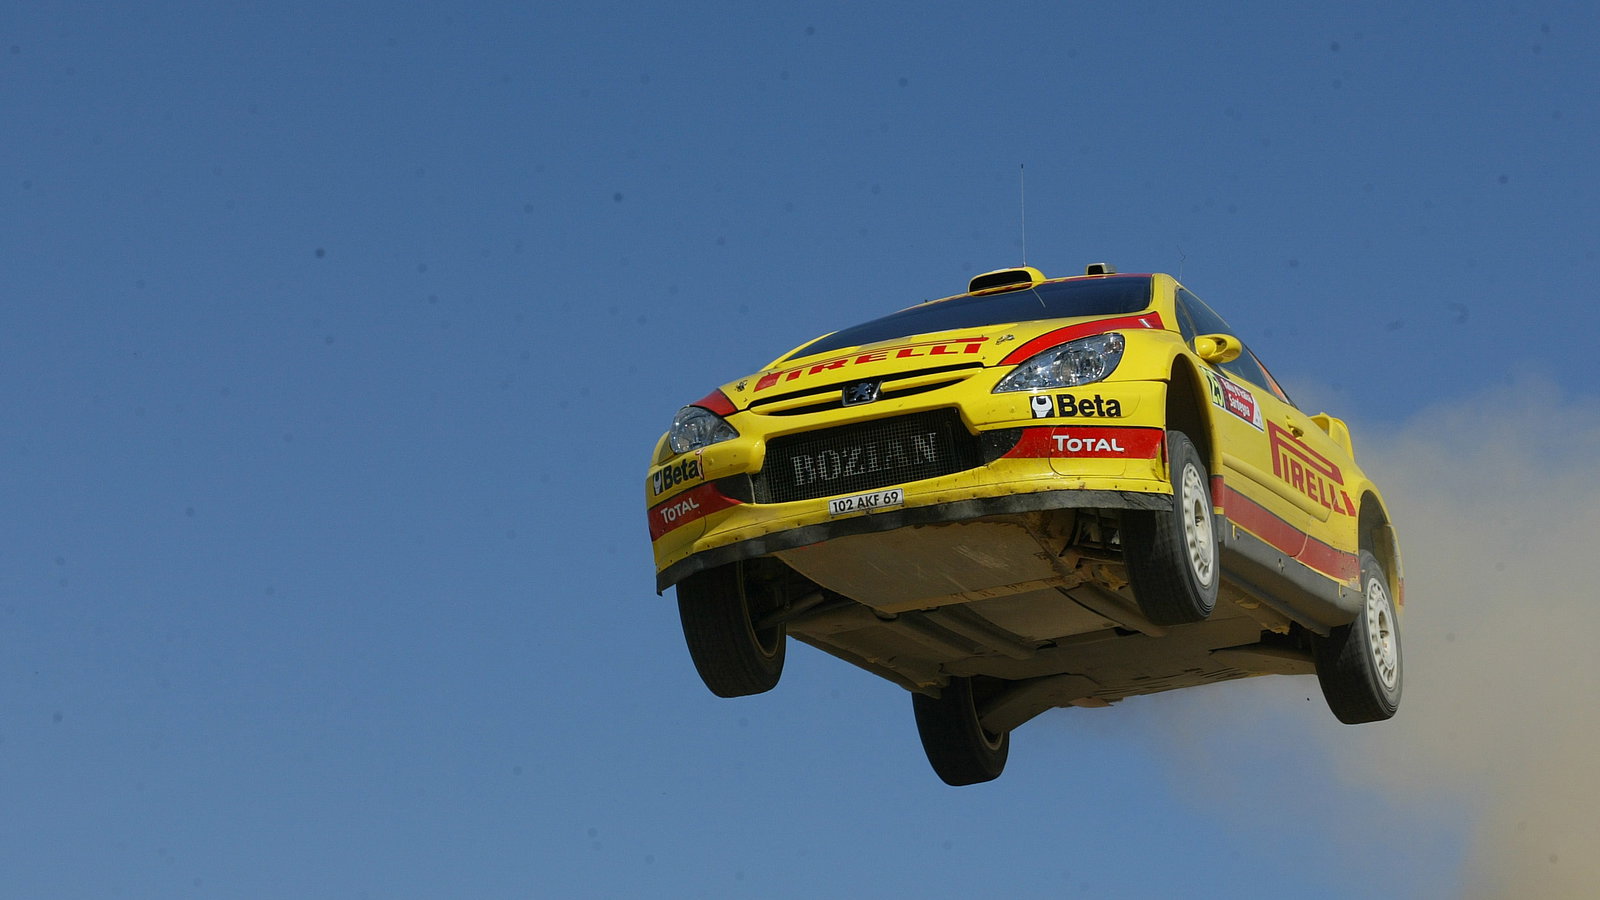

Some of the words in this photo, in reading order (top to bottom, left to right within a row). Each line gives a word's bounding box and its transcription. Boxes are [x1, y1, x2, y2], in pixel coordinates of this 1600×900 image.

[754, 337, 989, 392] PIRELLI
[1056, 394, 1121, 417] Beta
[1053, 435, 1124, 452] TOTAL
[791, 432, 936, 486] BOZIAN
[1267, 419, 1356, 517] PIRELLI
[663, 459, 699, 490] Beta
[661, 497, 699, 523] TOTAL
[833, 499, 853, 512] 102
[857, 494, 879, 508] AKF
[884, 491, 898, 504] 69
